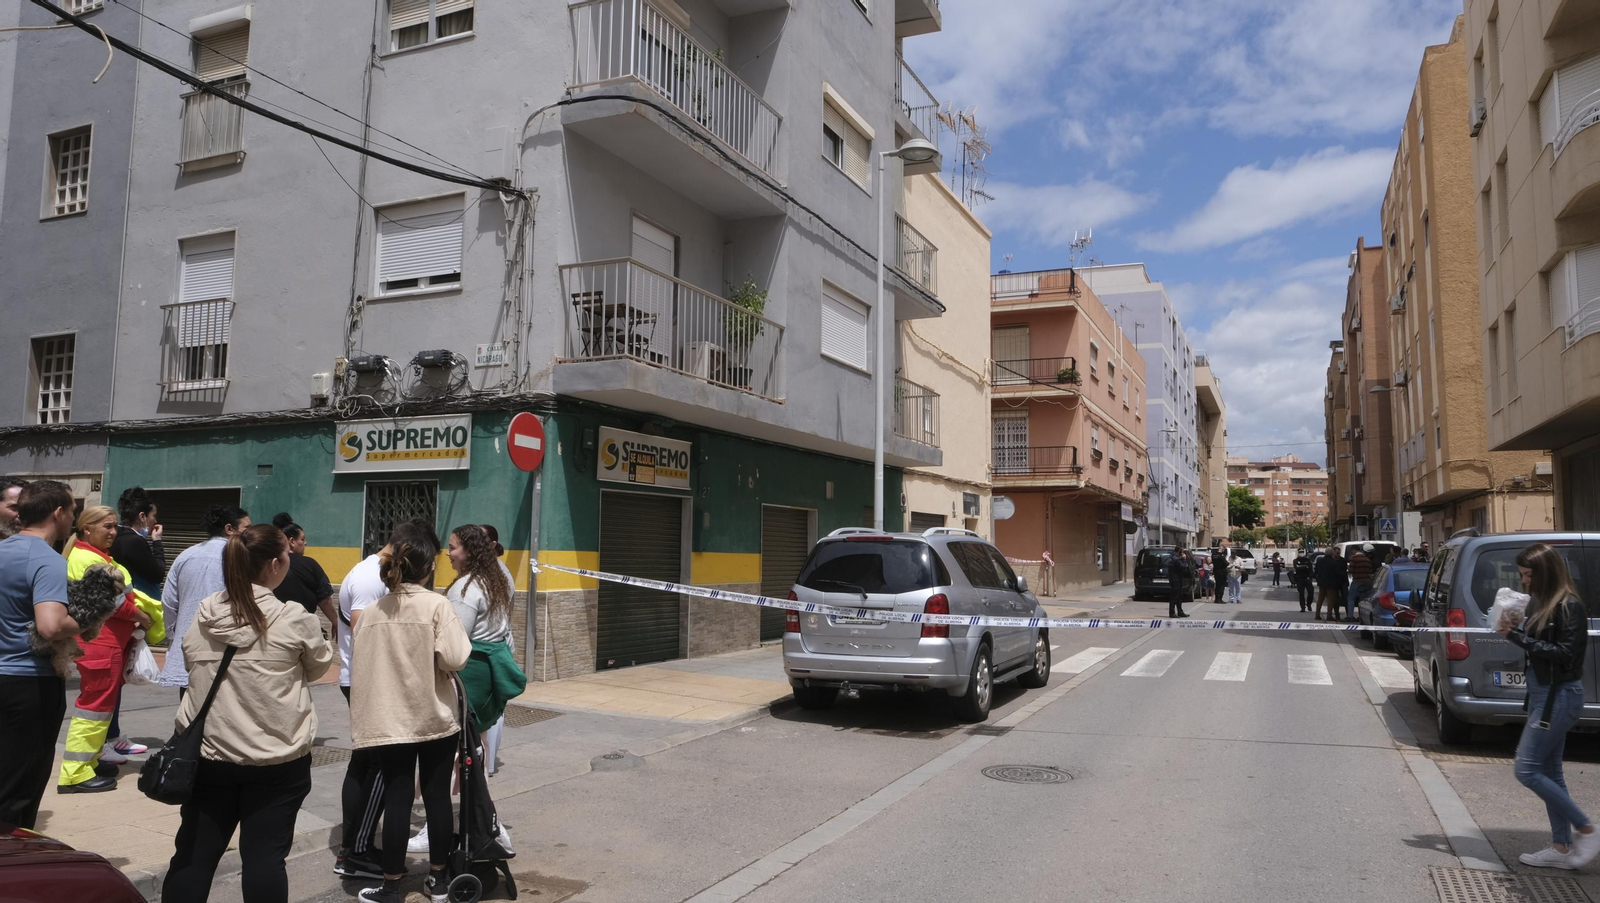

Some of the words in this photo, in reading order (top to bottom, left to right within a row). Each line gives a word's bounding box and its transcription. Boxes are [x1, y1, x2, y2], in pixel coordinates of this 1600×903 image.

[477, 354, 503, 363] NICARAGU
[366, 426, 468, 451] SUPREMO
[366, 450, 465, 460] Supermercados
[630, 452, 636, 462] SE
[637, 454, 655, 465] ALQUILA
[702, 486, 710, 497] 27
